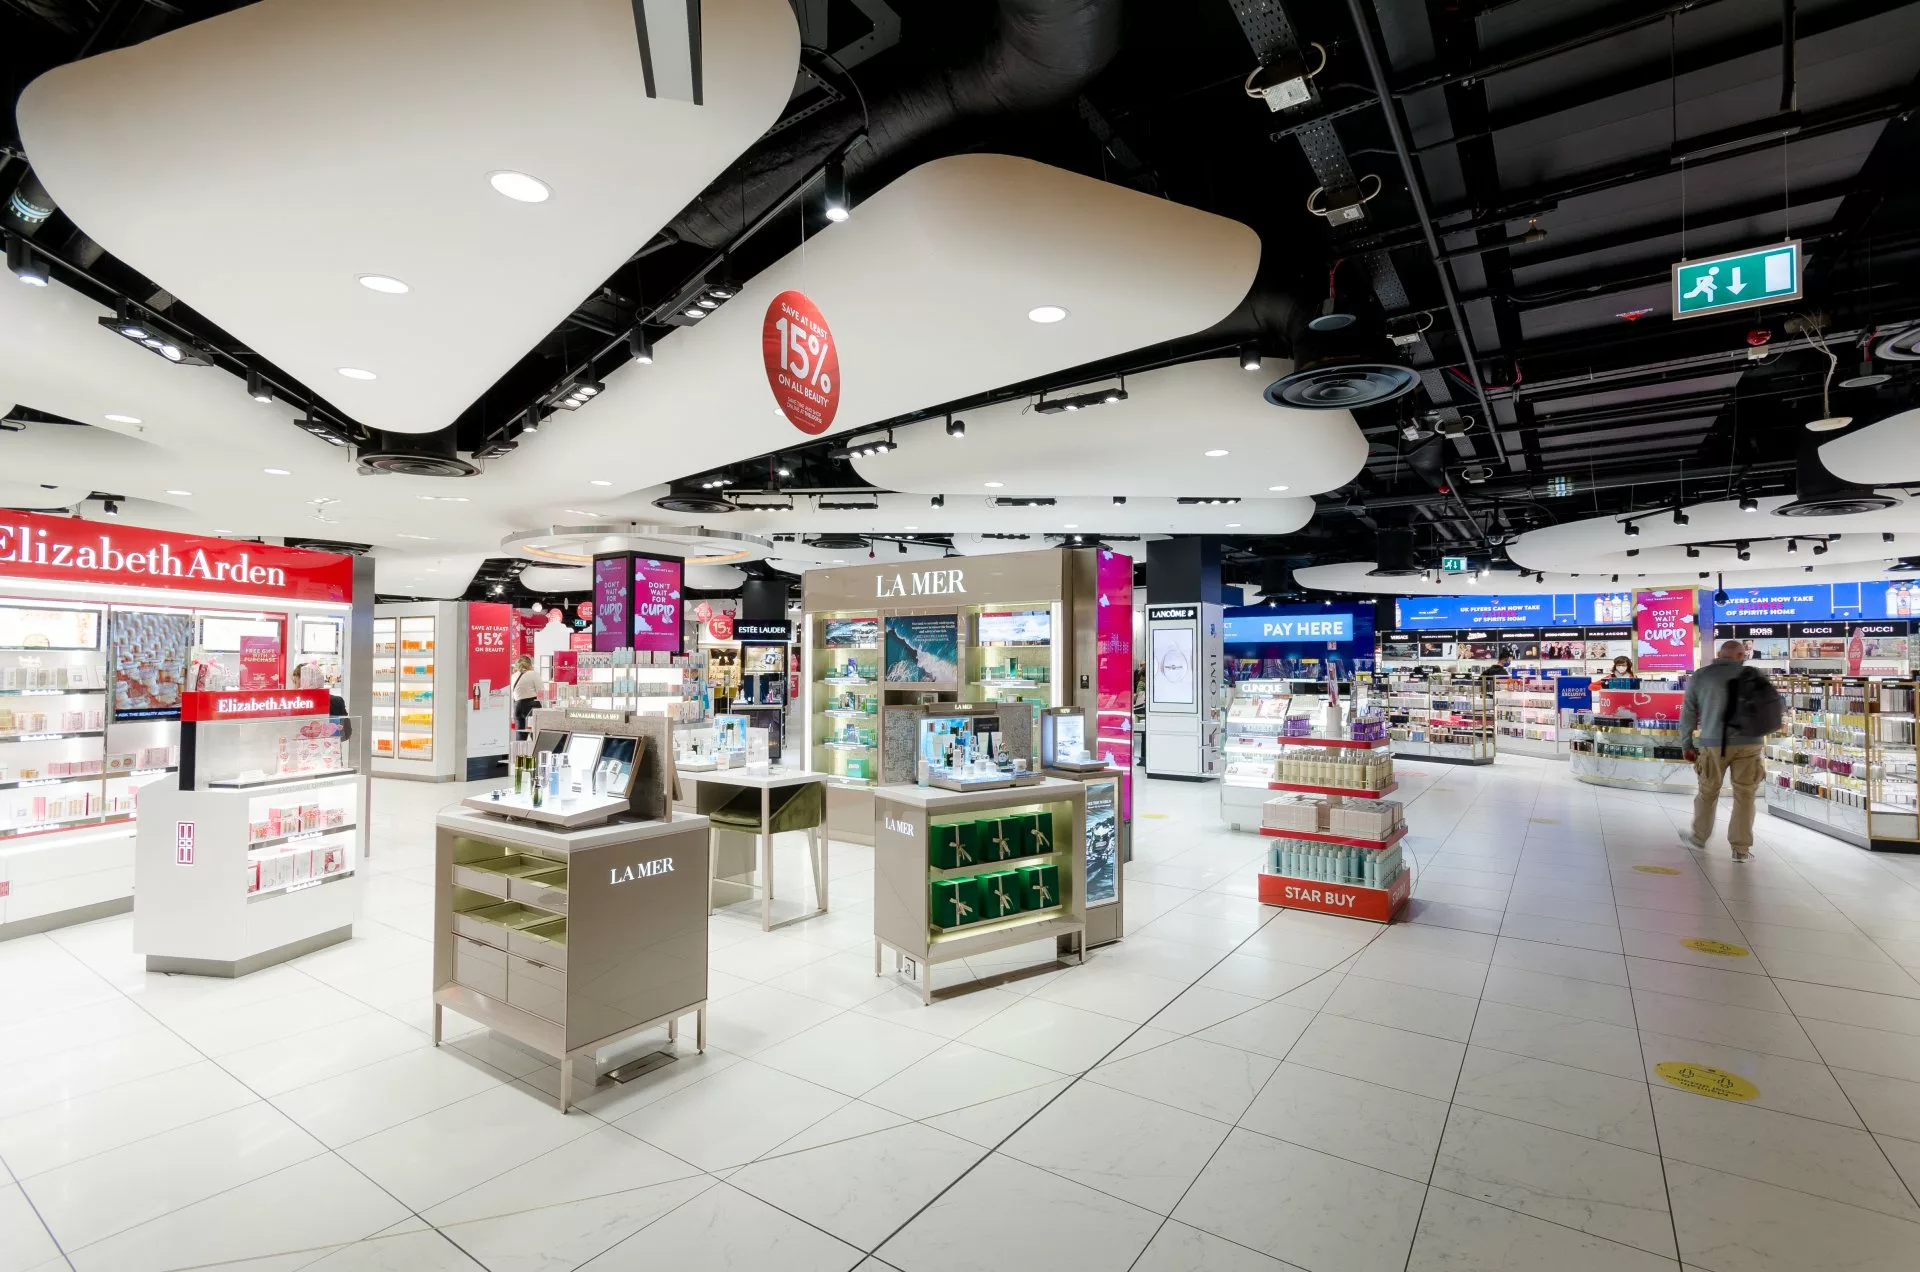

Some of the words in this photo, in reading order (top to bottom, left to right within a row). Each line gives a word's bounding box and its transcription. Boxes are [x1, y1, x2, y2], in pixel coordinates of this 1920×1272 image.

[781, 302, 800, 322] SAVE
[800, 315, 809, 328] AT
[809, 320, 828, 340] LEAST
[775, 316, 832, 394] 15%
[778, 373, 791, 389] ON
[791, 381, 804, 395] ALL
[0, 525, 183, 578] Elizabeth
[184, 548, 287, 587] Arden
[648, 581, 671, 589] DON'T
[875, 574, 907, 598] LA
[911, 569, 967, 596] MER
[650, 588, 668, 596] WAIT
[651, 595, 666, 603] FOR
[599, 602, 623, 617] CUPID
[641, 602, 675, 617] CUPID
[1151, 608, 1187, 618] LANCÔME
[759, 626, 786, 634] LAUDER
[1263, 623, 1293, 637] PAY
[1297, 621, 1344, 636] HERE
[1644, 628, 1687, 641] CUPID
[476, 632, 504, 646] 15%
[1241, 683, 1283, 694] CLINIQUE
[217, 697, 278, 713] Elizabeth
[279, 697, 314, 710] Arden
[885, 817, 897, 832] LA
[896, 819, 915, 838] MER
[610, 865, 635, 885] LA
[637, 857, 675, 879] MER
[1284, 885, 1321, 903] STAR
[1325, 893, 1356, 908] BUY
